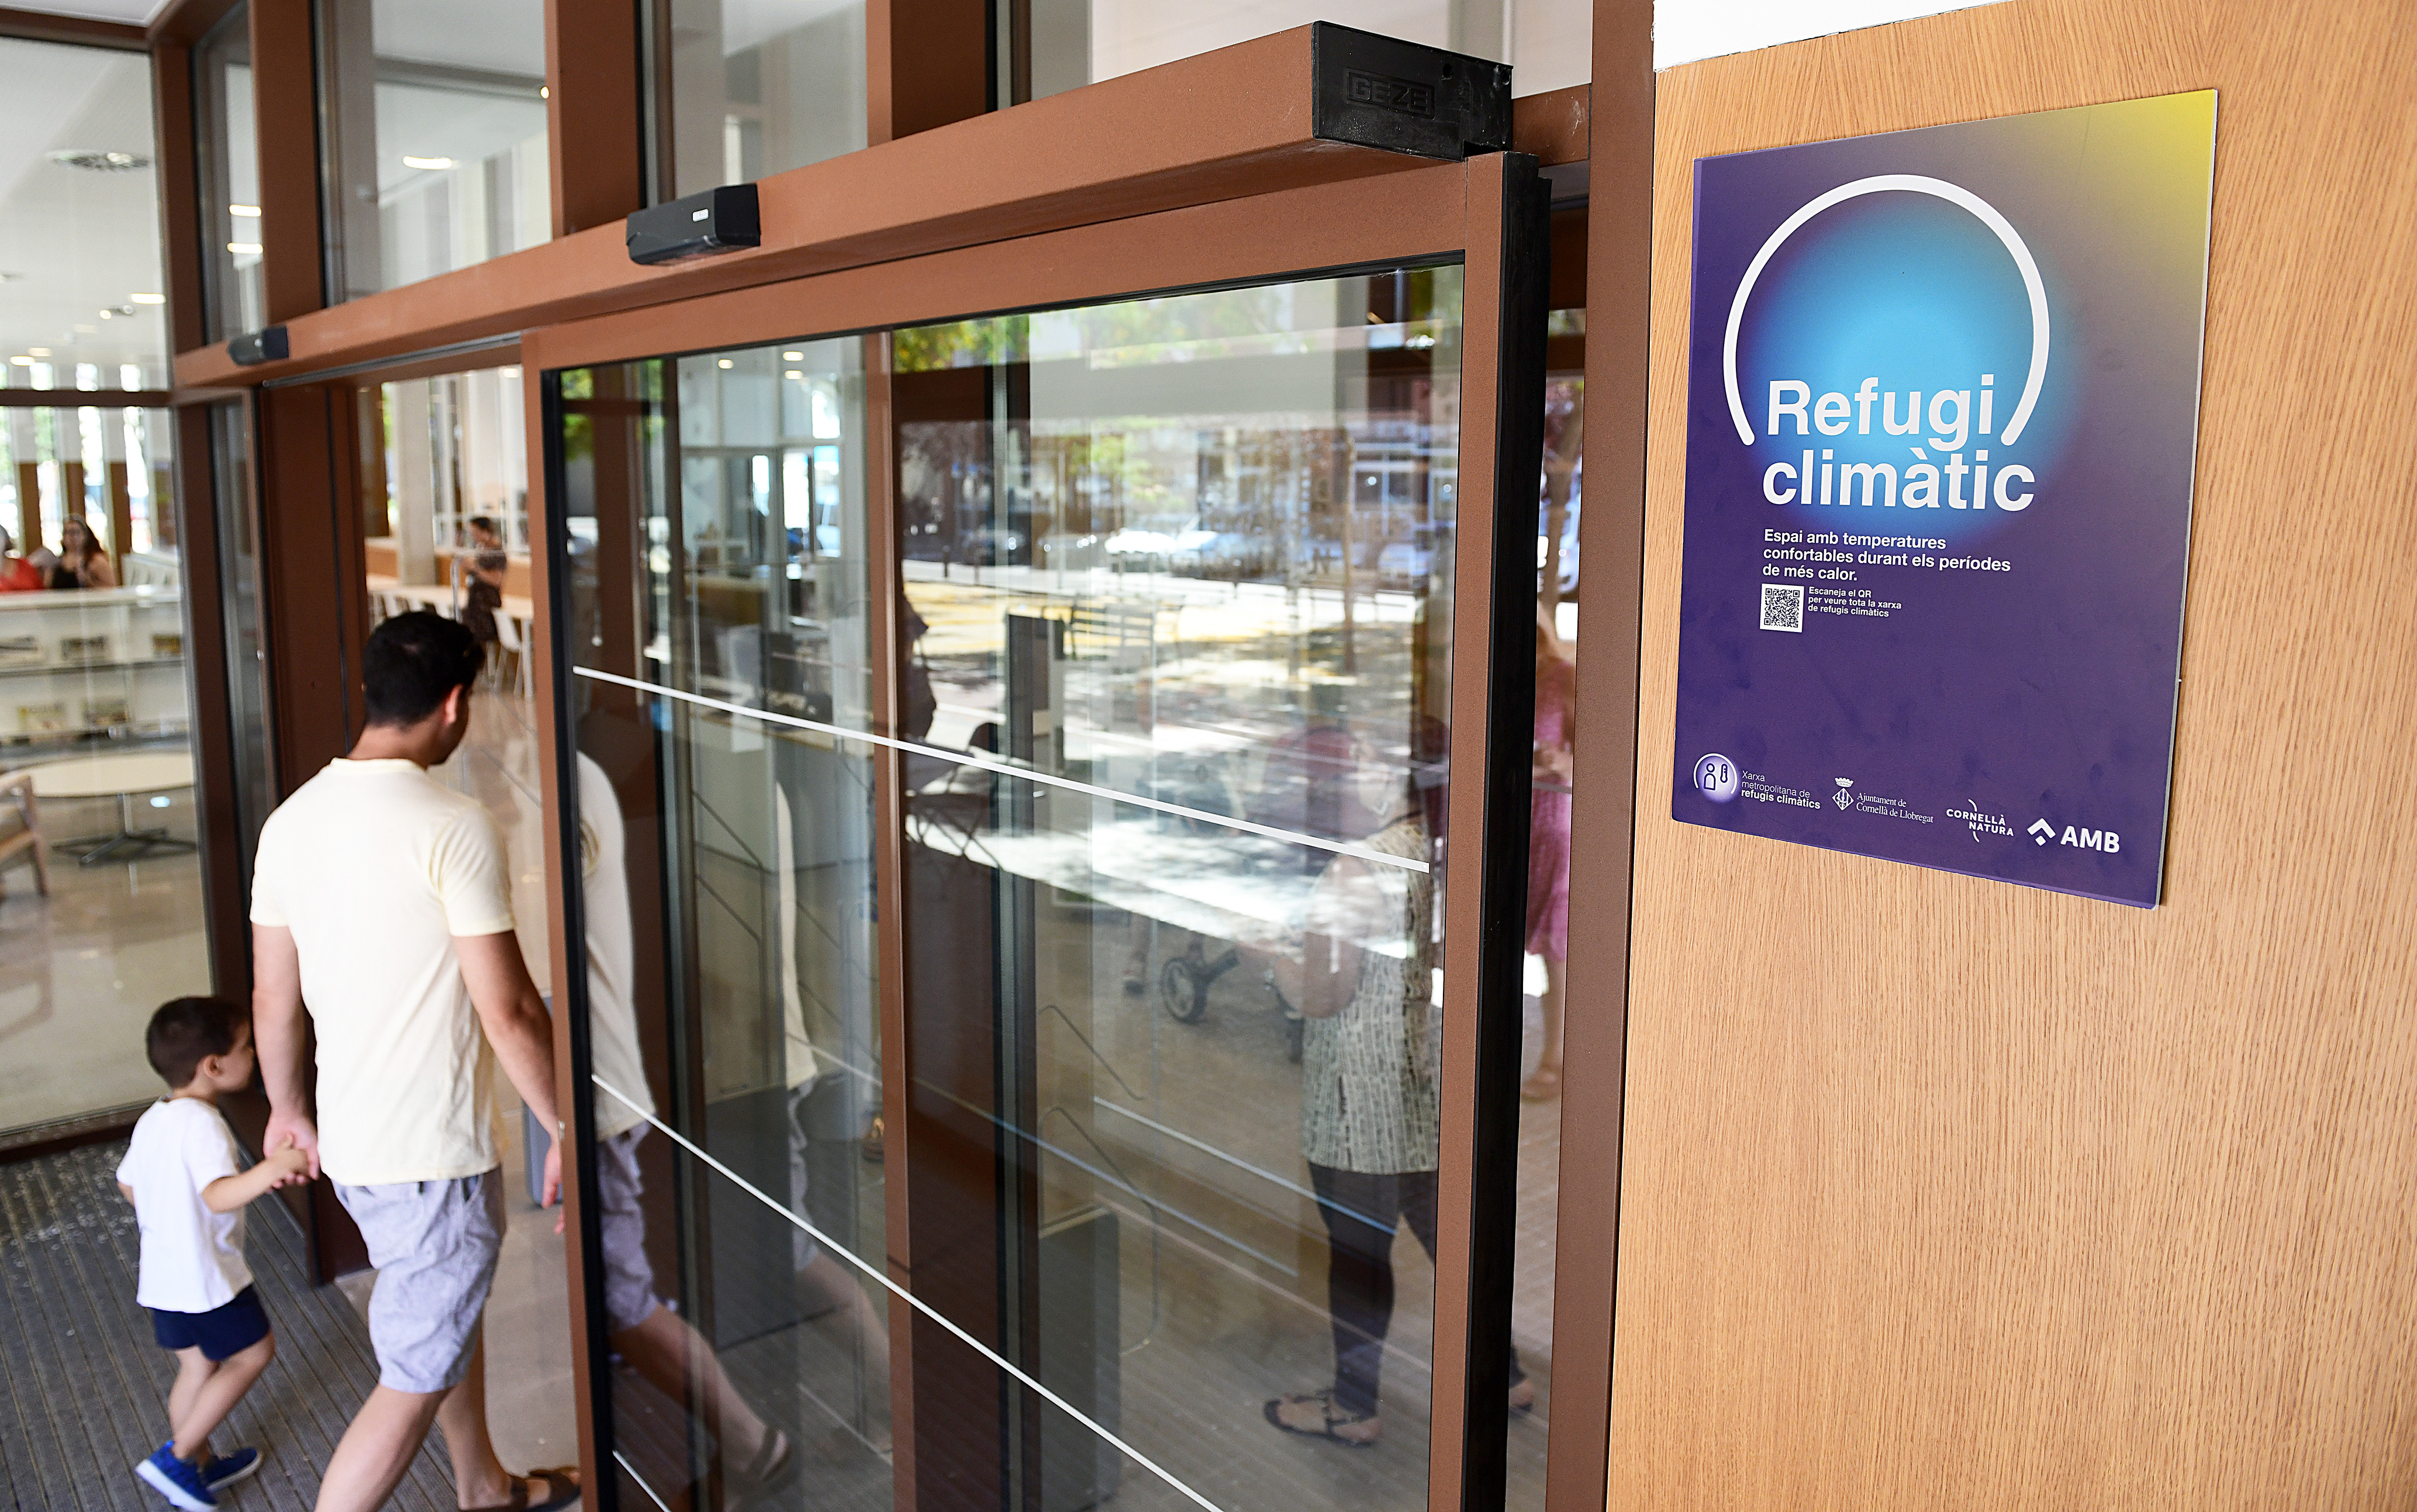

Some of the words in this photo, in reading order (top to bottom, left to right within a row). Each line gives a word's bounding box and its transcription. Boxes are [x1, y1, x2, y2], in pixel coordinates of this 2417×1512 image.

[1352, 77, 1428, 112] GEZE
[1767, 374, 1995, 452] Refugi
[1762, 447, 2035, 512] climàtic
[1765, 529, 1803, 544] Espai
[1807, 531, 1839, 544] amb
[1843, 532, 1946, 549] temperatures
[1763, 547, 1853, 562] confortables
[1857, 551, 1908, 566] durant
[1912, 554, 1935, 567] els
[1939, 555, 2011, 571] períodes
[1762, 563, 1780, 577] de
[1784, 565, 1814, 578] més
[1818, 567, 1857, 581] calor.
[1808, 586, 1846, 597] Escaneja
[1858, 590, 1872, 598] QR
[1820, 606, 1849, 615] refugis
[1850, 607, 1889, 617] climàtics
[1742, 770, 1765, 782] Xarxa
[1741, 781, 1797, 796] metropolitana
[1799, 789, 1810, 798] de
[1741, 789, 1774, 802] refugis
[1776, 795, 1821, 809] climàtics
[1857, 792, 1897, 806] Ajuntament
[1898, 799, 1907, 807] de
[1856, 802, 1888, 816] Cornellà
[1889, 808, 1898, 817] de
[1900, 809, 1933, 824] Llobregat
[1946, 809, 2006, 826] CORNELLÀ
[1968, 821, 2014, 837] NATURA
[2060, 825, 2121, 853] AMB
